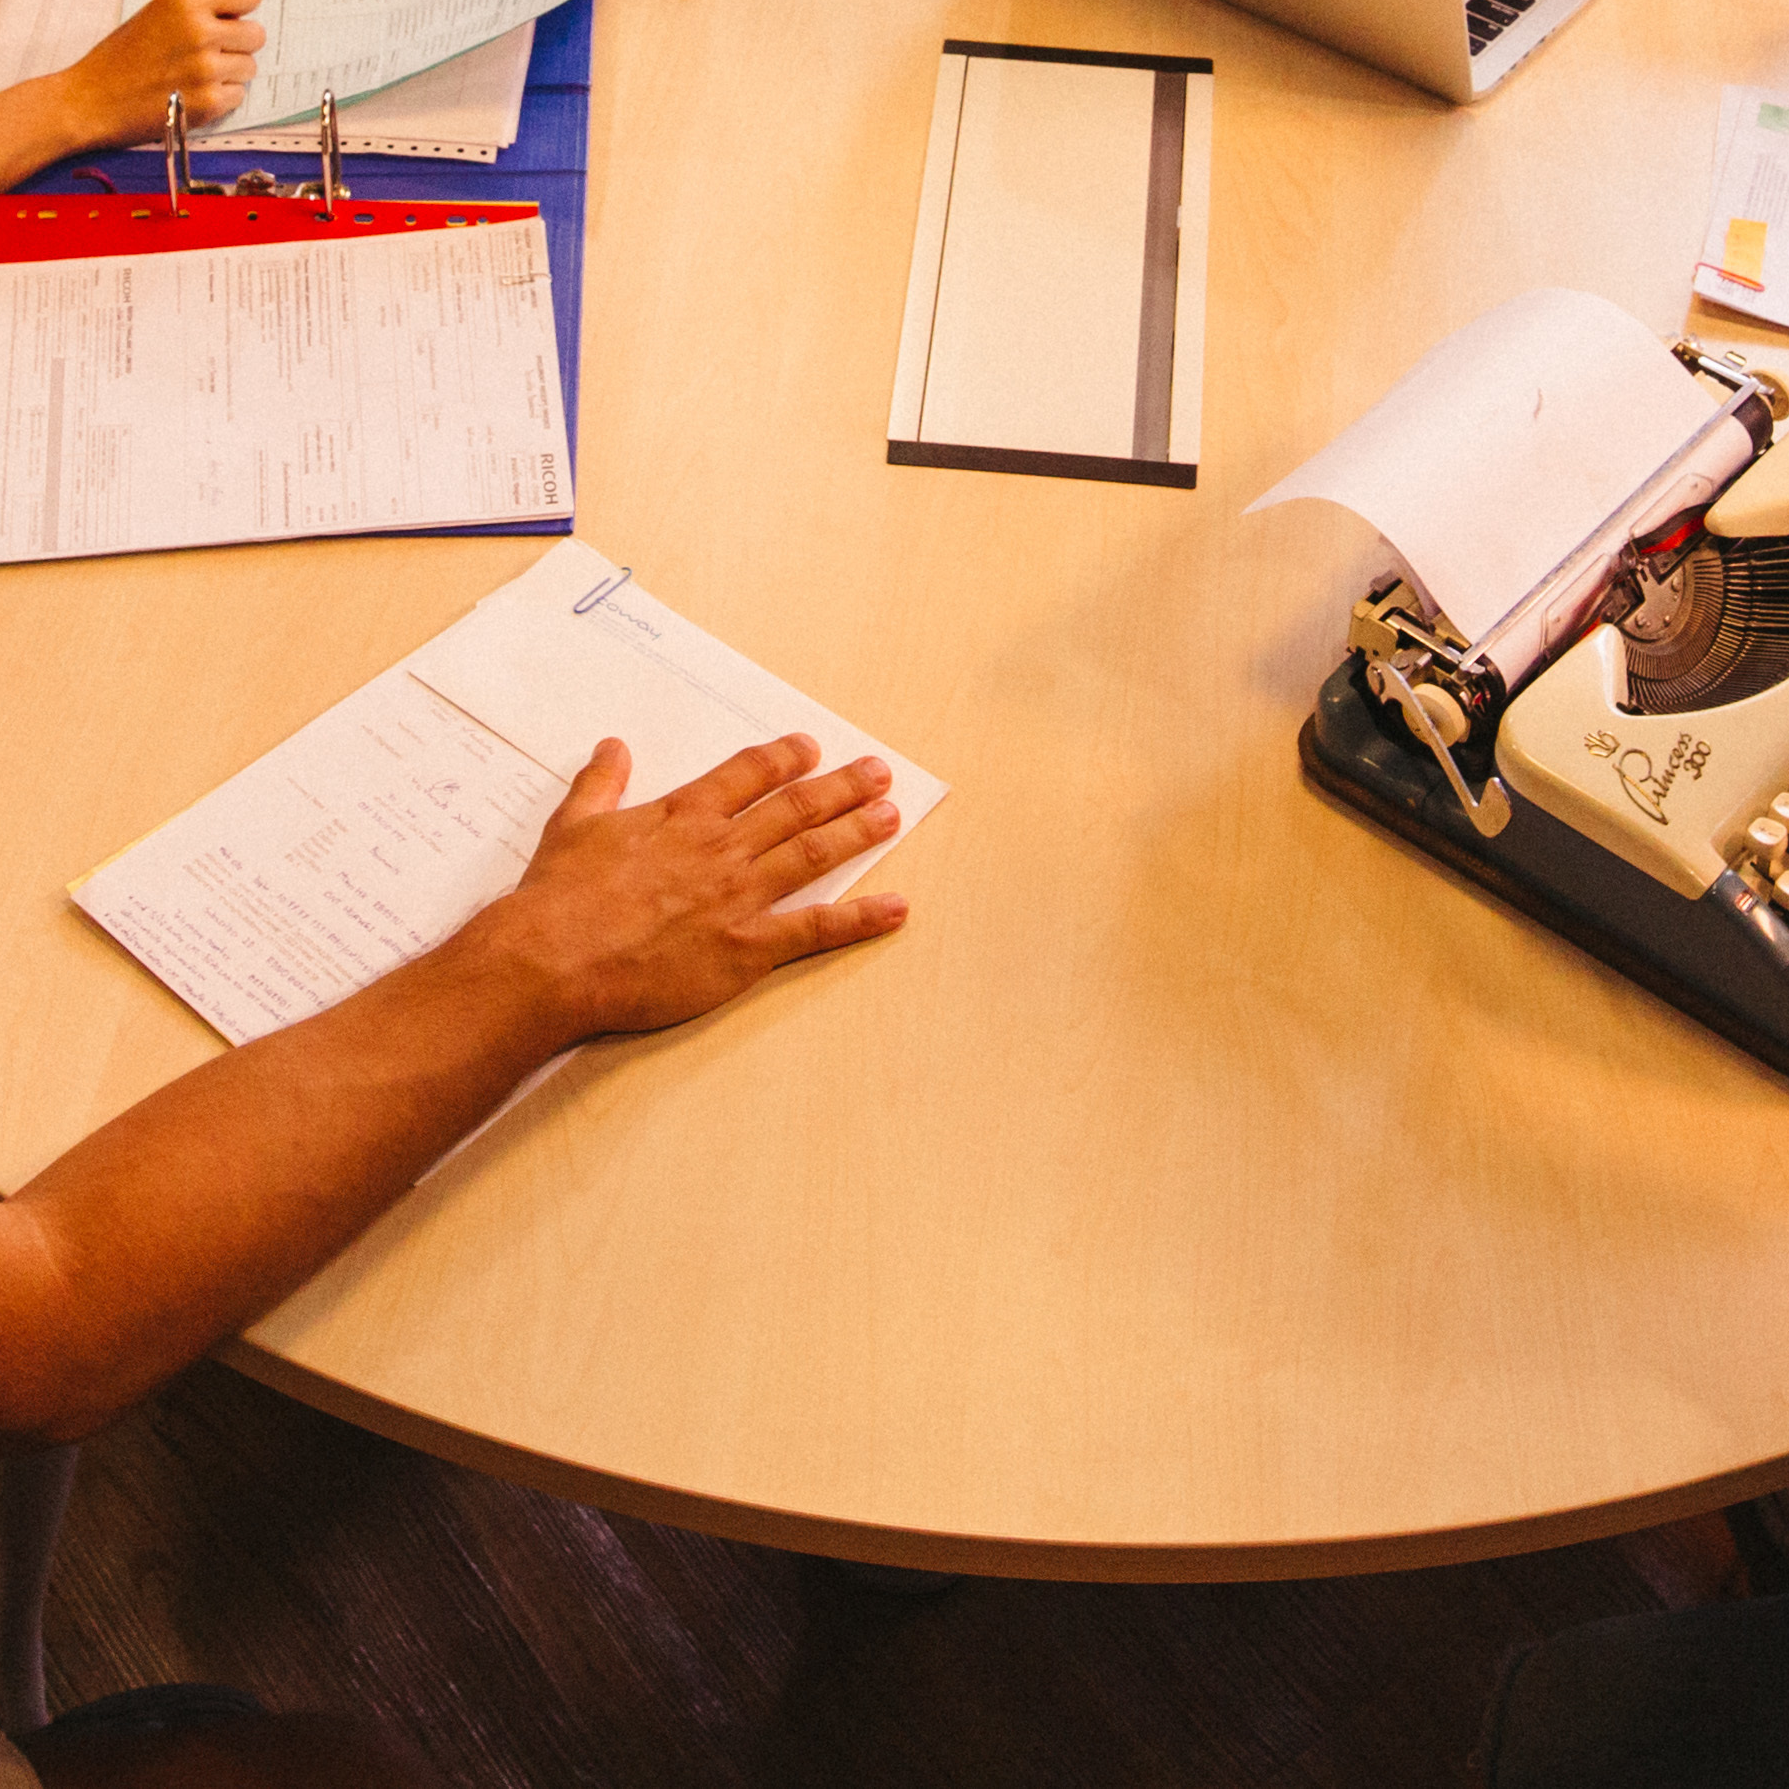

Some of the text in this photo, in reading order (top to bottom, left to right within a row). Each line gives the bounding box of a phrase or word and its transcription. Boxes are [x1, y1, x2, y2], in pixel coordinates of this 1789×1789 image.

[540, 453, 559, 505] RICOH
[1612, 731, 1692, 825] Princess
[1683, 741, 1711, 780] 300
